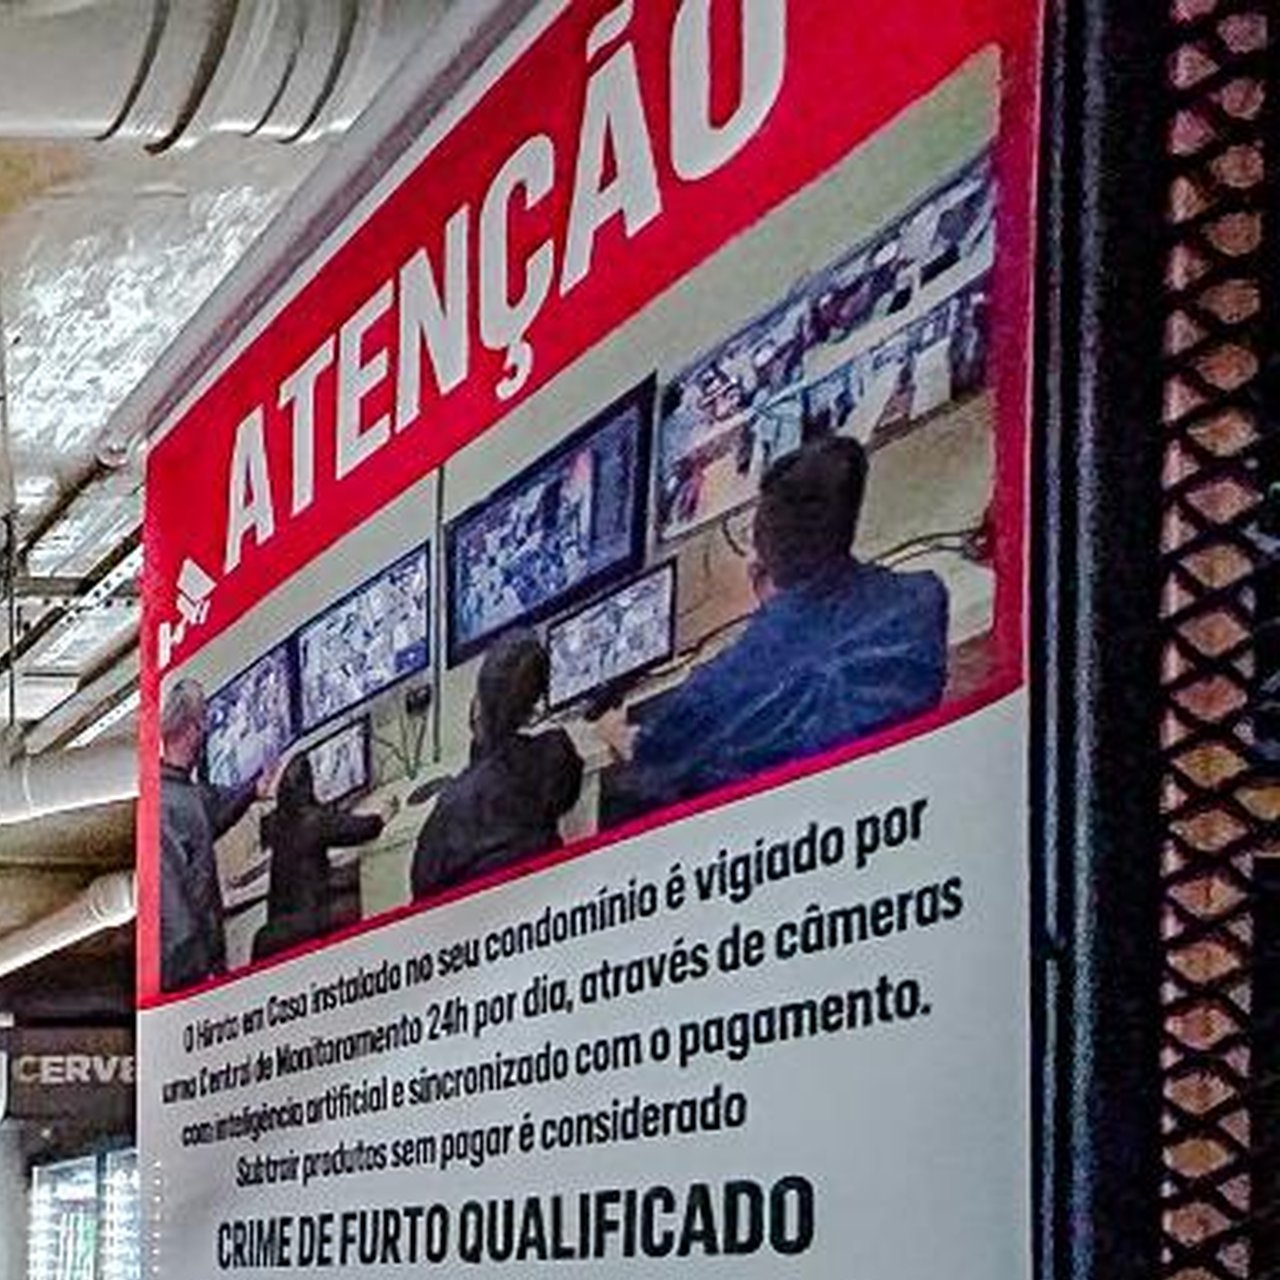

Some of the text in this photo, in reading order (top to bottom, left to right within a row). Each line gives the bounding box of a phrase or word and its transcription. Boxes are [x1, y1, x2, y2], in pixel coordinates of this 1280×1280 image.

[223, 0, 788, 573] ATENÇÃO
[267, 990, 307, 1027] Casa
[310, 960, 401, 1014] instalado
[406, 952, 433, 984] no
[437, 938, 479, 976] seu
[484, 879, 658, 962] condomínio
[666, 862, 686, 909] é
[694, 822, 844, 904] vigiado
[856, 798, 928, 869] por
[276, 1012, 422, 1077] Monitoramento
[426, 997, 468, 1041] 24h
[474, 991, 516, 1038] por
[522, 974, 574, 1014] dia,
[579, 936, 710, 1004] através
[717, 923, 765, 973] de
[775, 875, 963, 960] câmeras
[302, 1141, 387, 1186] produtos
[391, 1134, 436, 1169] sem
[440, 1123, 514, 1171] pagar
[519, 1112, 535, 1152] é
[542, 1083, 748, 1151] considerado
[306, 1075, 388, 1125] artificial
[392, 1079, 405, 1108] e
[408, 1039, 569, 1106] sincronizado
[575, 1030, 643, 1076] com
[650, 1027, 671, 1061] o
[679, 975, 932, 1067] pagamento.
[217, 1174, 816, 1270] CRIME DE FURTO QUALIFICADO
